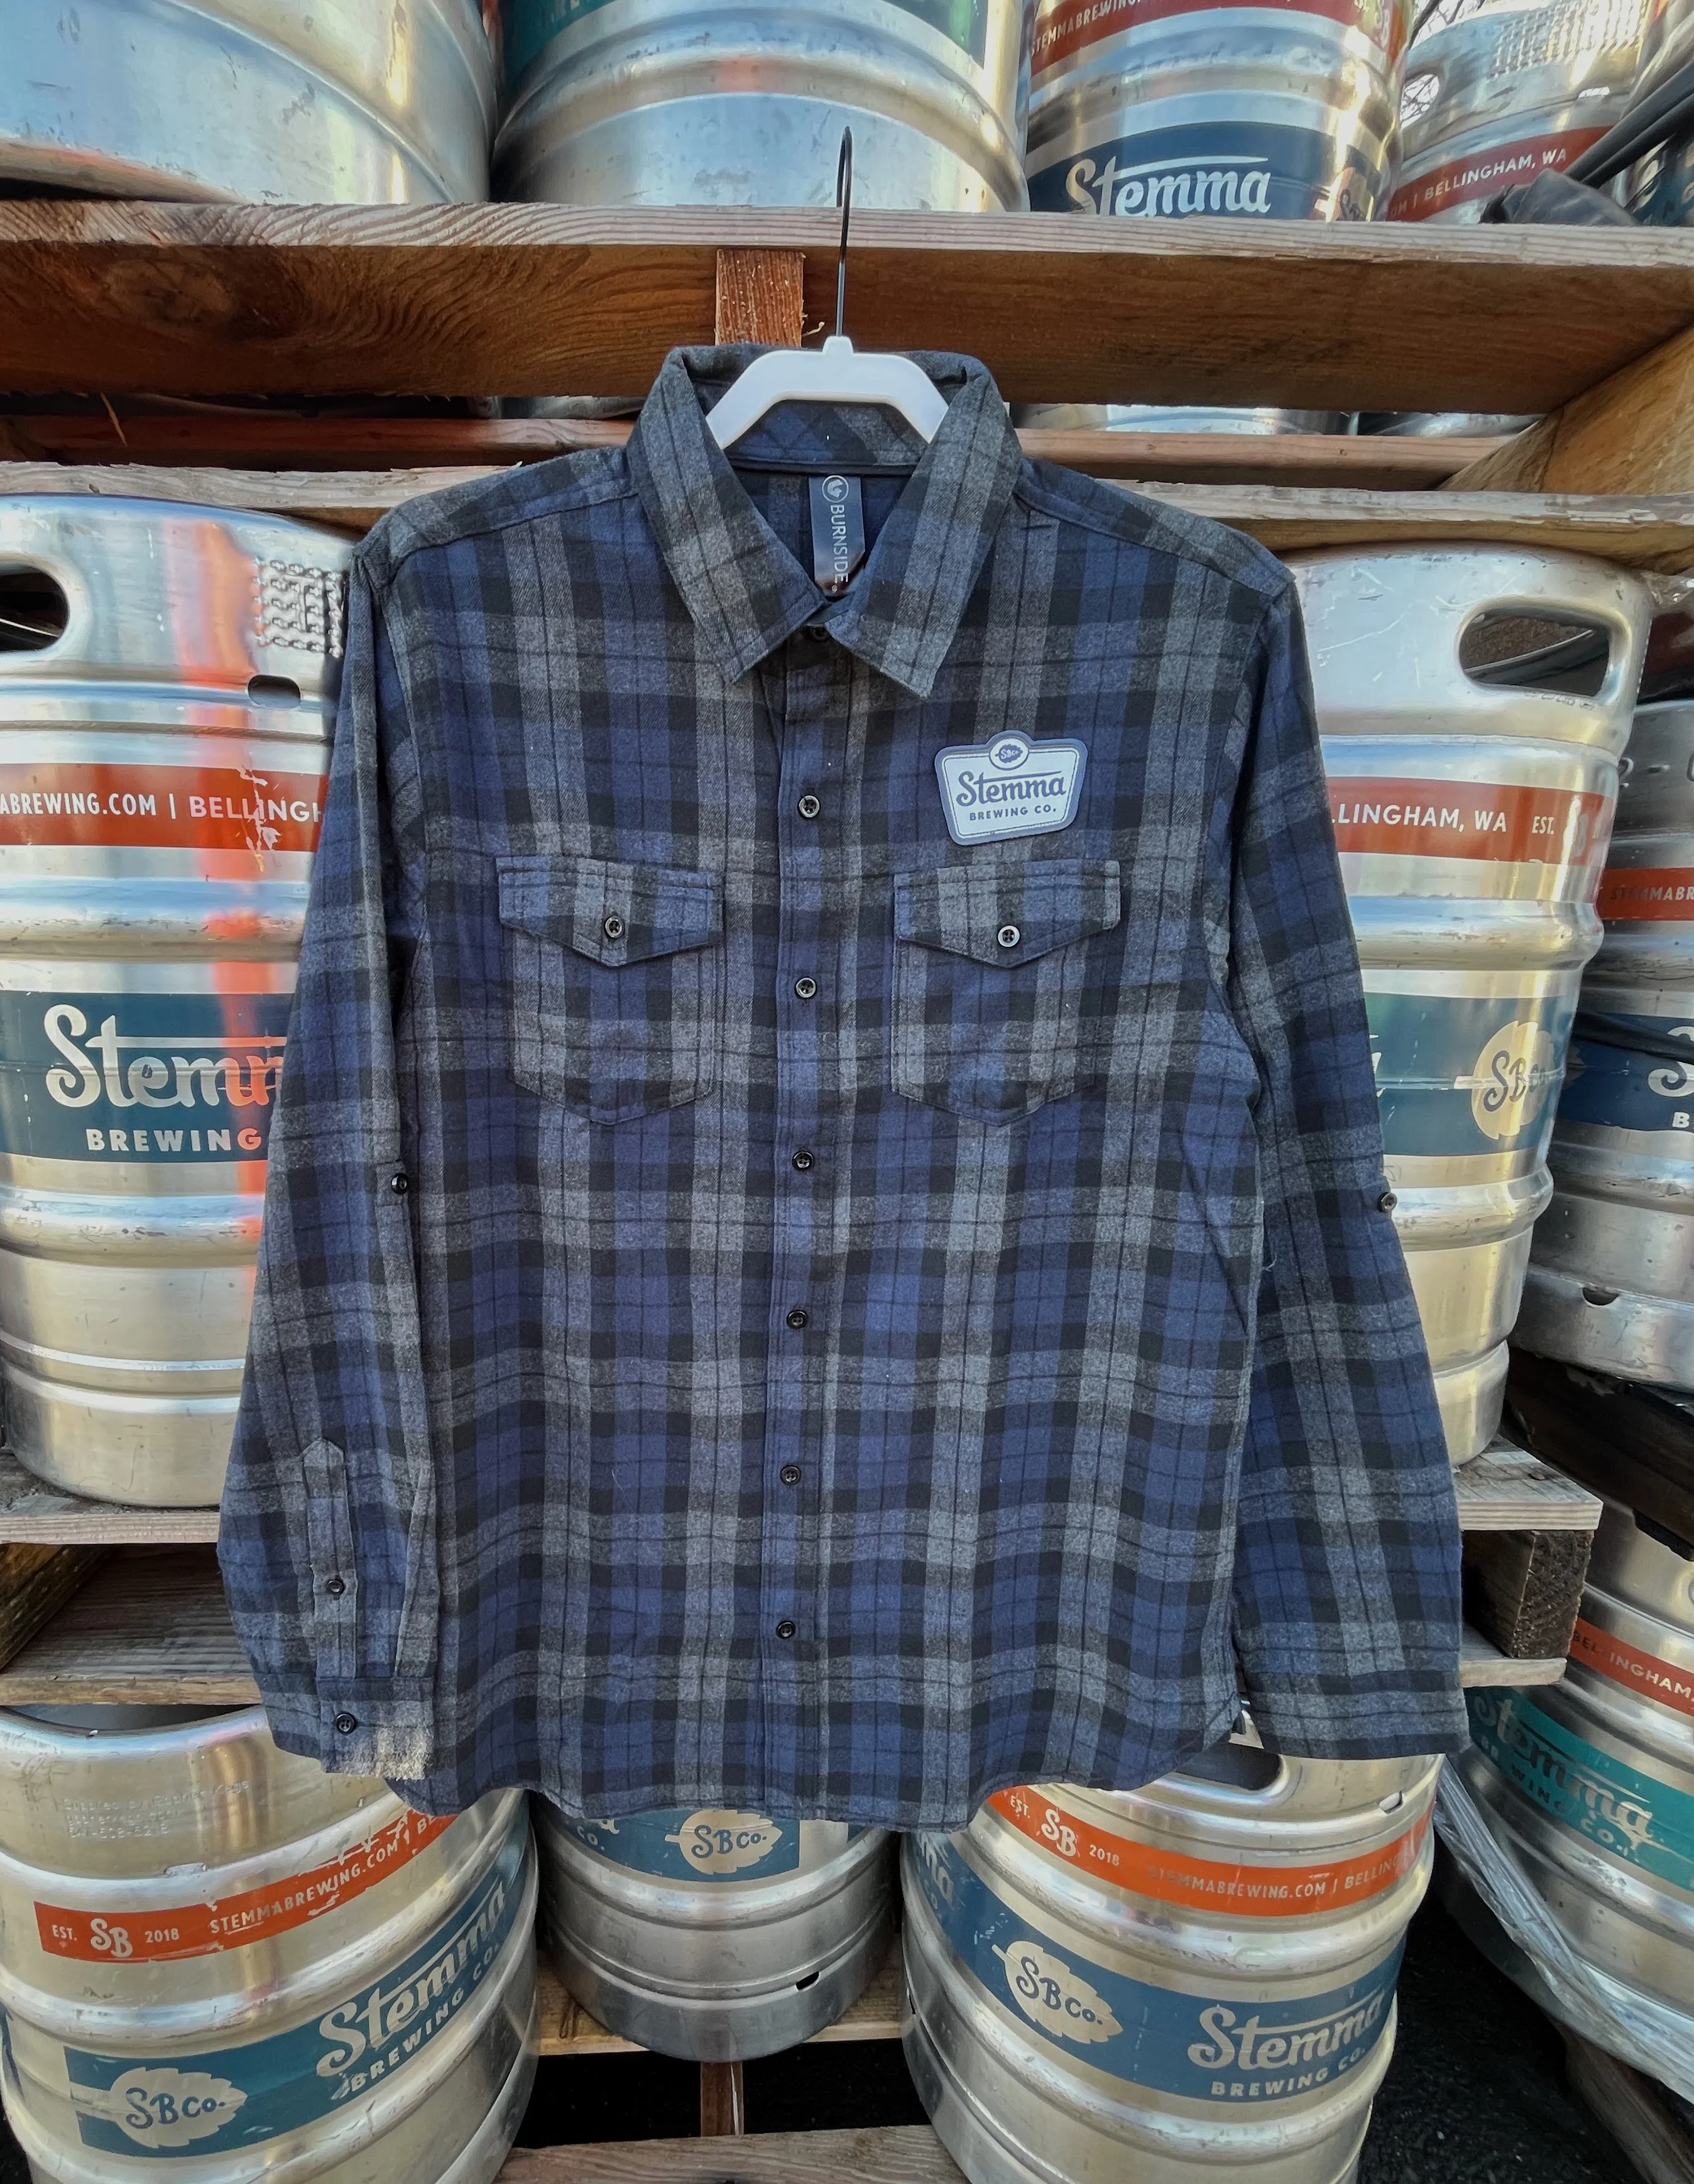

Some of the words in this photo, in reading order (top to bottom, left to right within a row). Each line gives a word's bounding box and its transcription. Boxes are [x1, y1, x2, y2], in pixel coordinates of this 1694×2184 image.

[1066, 155, 1272, 217] Stemma
[1424, 154, 1536, 200] BELLINGHAM,
[1542, 148, 1566, 165] WA
[830, 504, 848, 583] BURNSIDE
[956, 771, 1066, 806] Stemma
[970, 806, 1029, 821] BREWING
[1034, 804, 1057, 813] CO.
[1331, 803, 1465, 833] LINGHAM,
[1475, 810, 1507, 832] WA
[1532, 816, 1555, 835] EST.
[86, 1128, 262, 1152] BREWING
[1010, 1795, 1031, 1818] EST.
[1089, 1844, 1120, 1867] 2018
[52, 1924, 77, 1941] EST.
[145, 1928, 180, 1943] 2018
[209, 1838, 398, 1934] STEMMABREWING.COM
[316, 1874, 506, 2077] Stemma
[349, 1987, 465, 2093] BREWING
[1187, 1984, 1385, 2070] Stemma
[1211, 2067, 1328, 2097] BREWING
